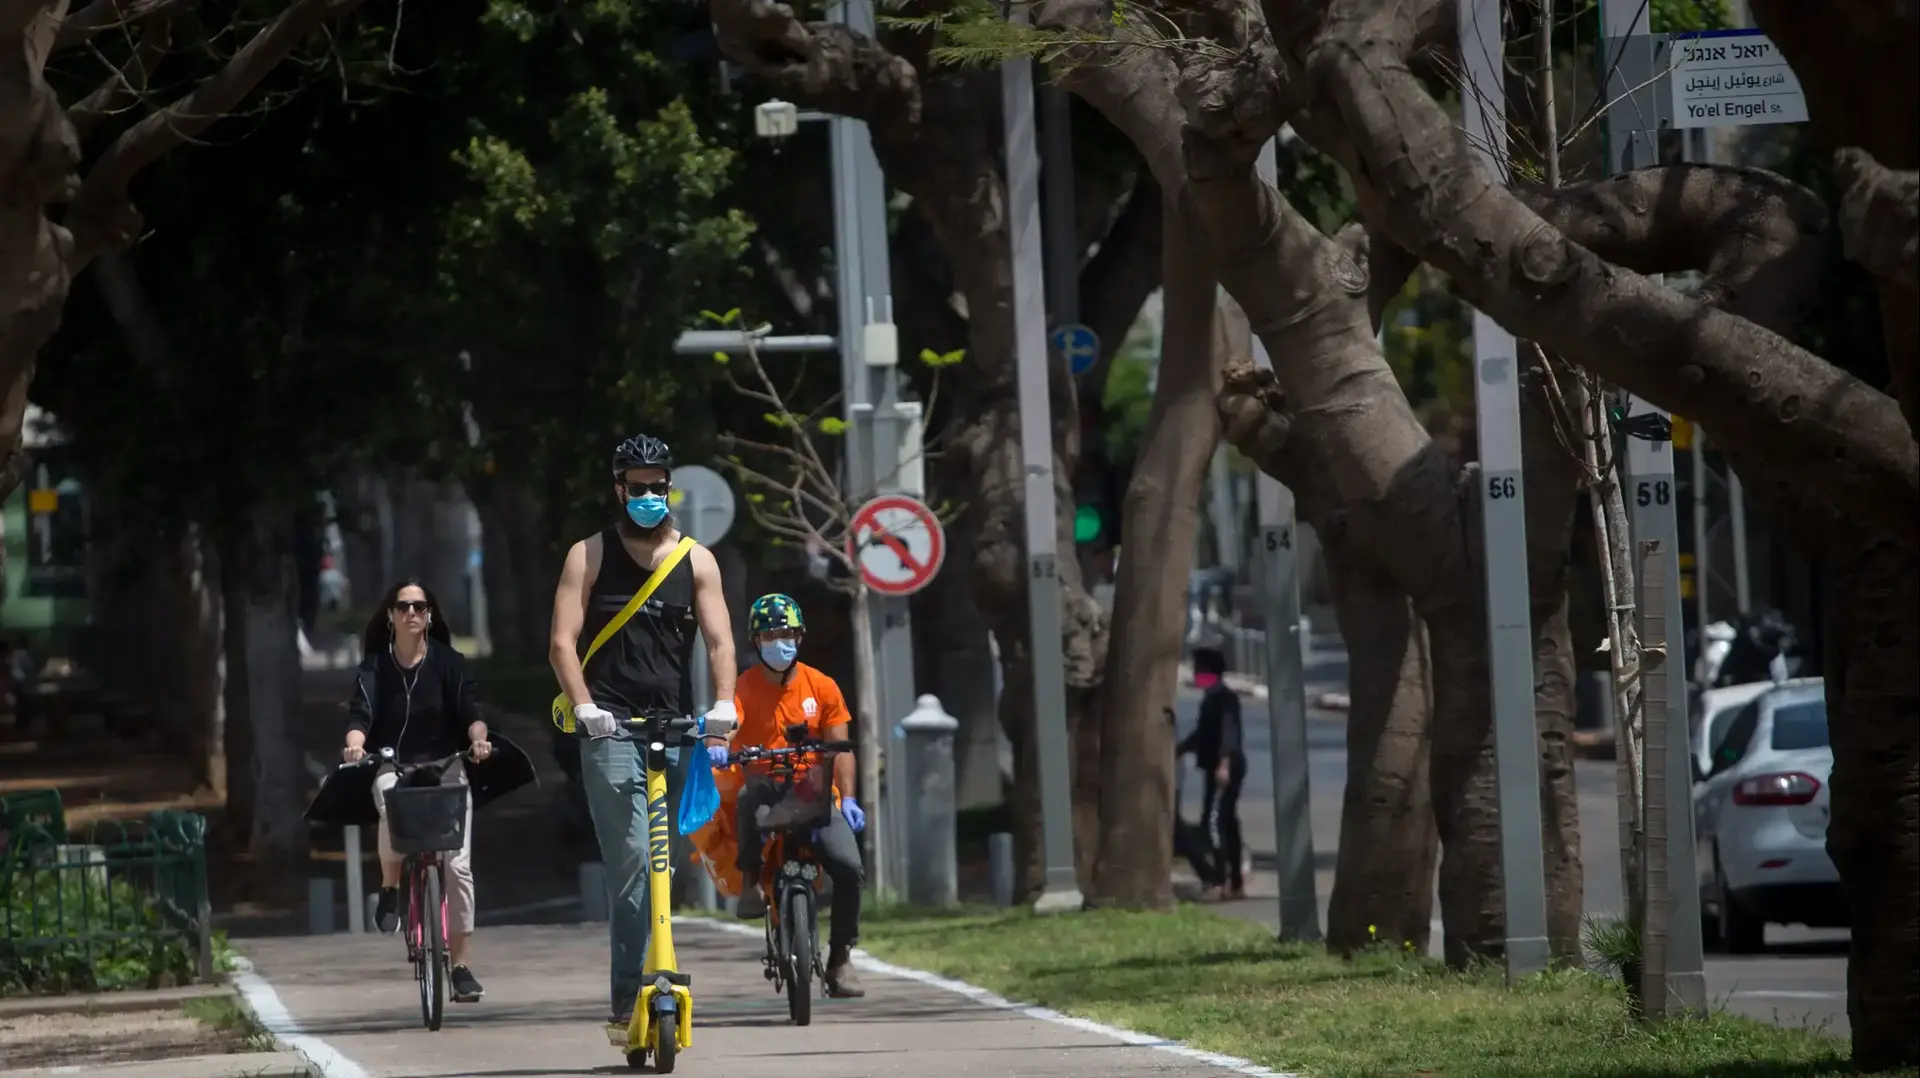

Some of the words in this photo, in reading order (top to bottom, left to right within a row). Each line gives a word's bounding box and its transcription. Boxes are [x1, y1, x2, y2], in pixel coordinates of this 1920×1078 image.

[1684, 47, 1726, 62] אנגל
[1731, 43, 1769, 59] יואל
[1763, 73, 1785, 87] شارع
[1687, 102, 1720, 118] Yo'el
[1725, 100, 1766, 118] Engel
[1489, 476, 1515, 499] 56
[1637, 481, 1670, 507] 58
[1266, 530, 1291, 551] 54
[648, 795, 668, 873] WIND
